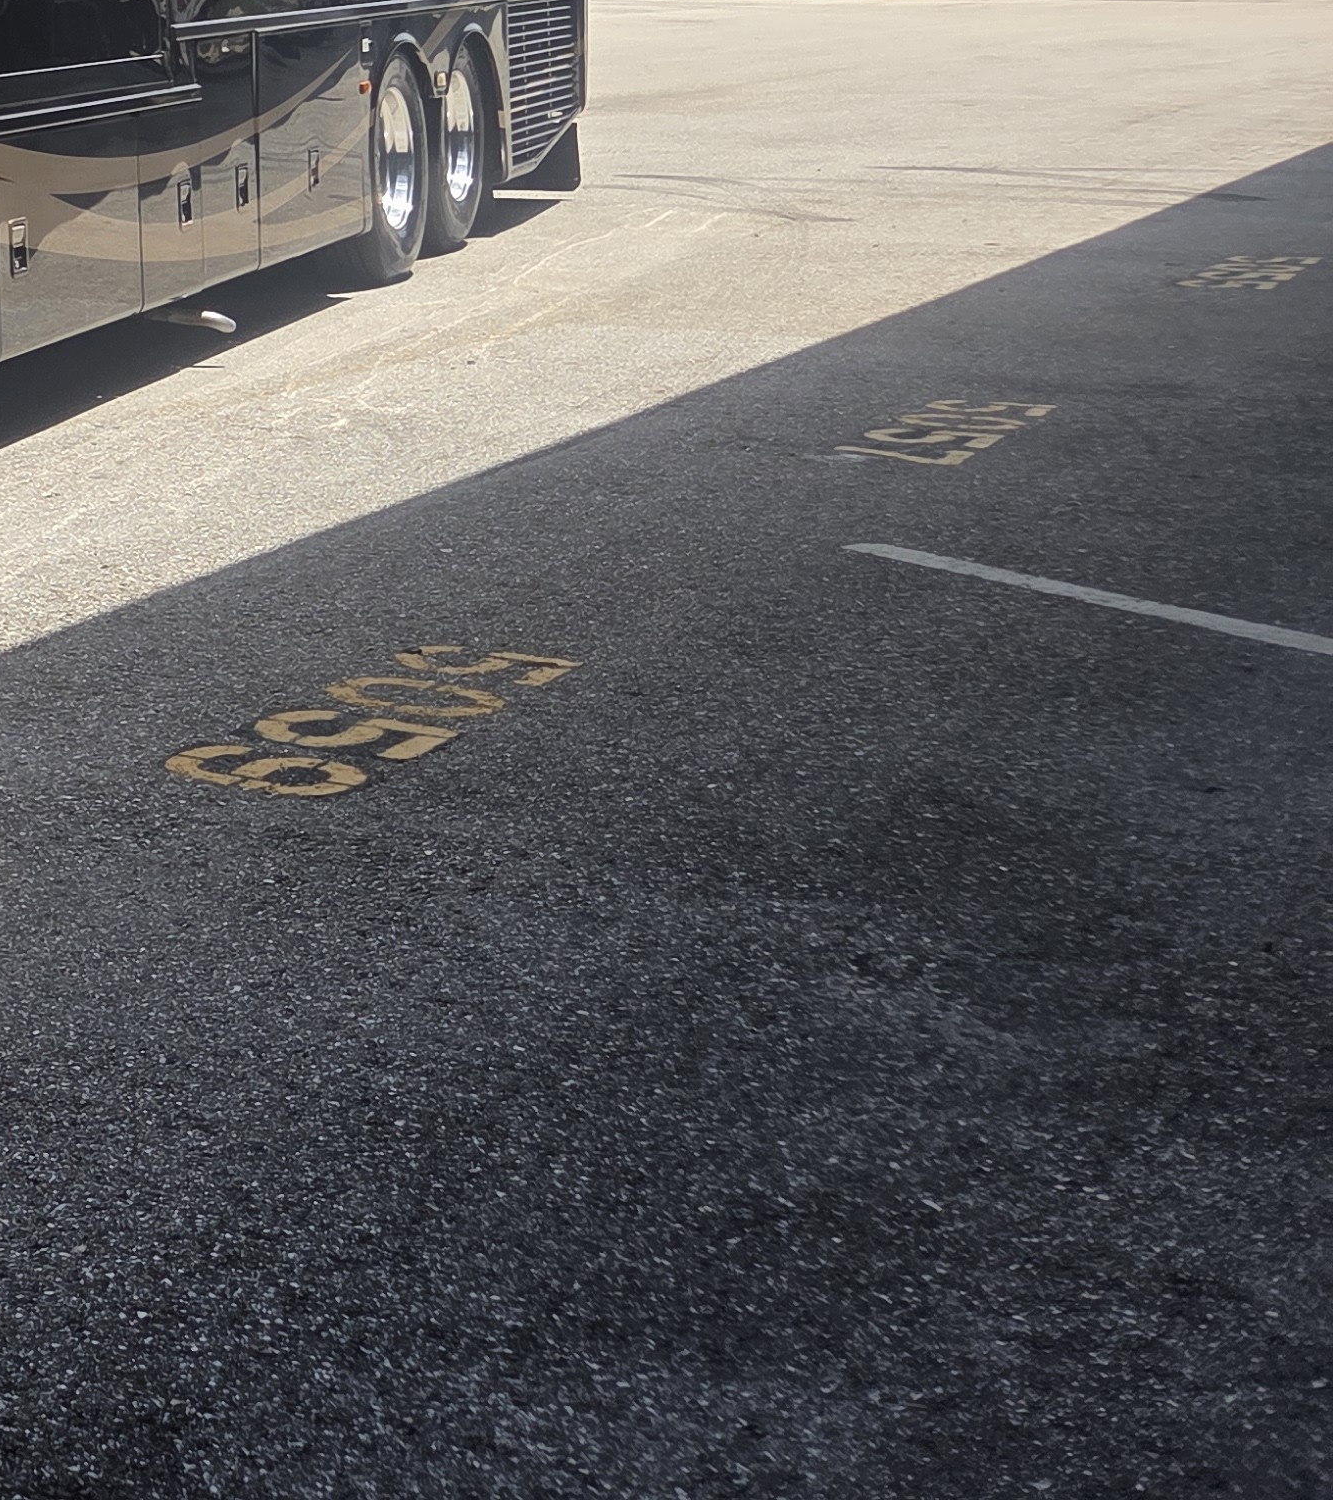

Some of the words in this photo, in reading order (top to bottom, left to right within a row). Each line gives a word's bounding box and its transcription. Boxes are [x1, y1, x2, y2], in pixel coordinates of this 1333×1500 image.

[1176, 254, 1324, 291] 5055
[833, 399, 1058, 466] 5057
[164, 645, 585, 797] 5059
